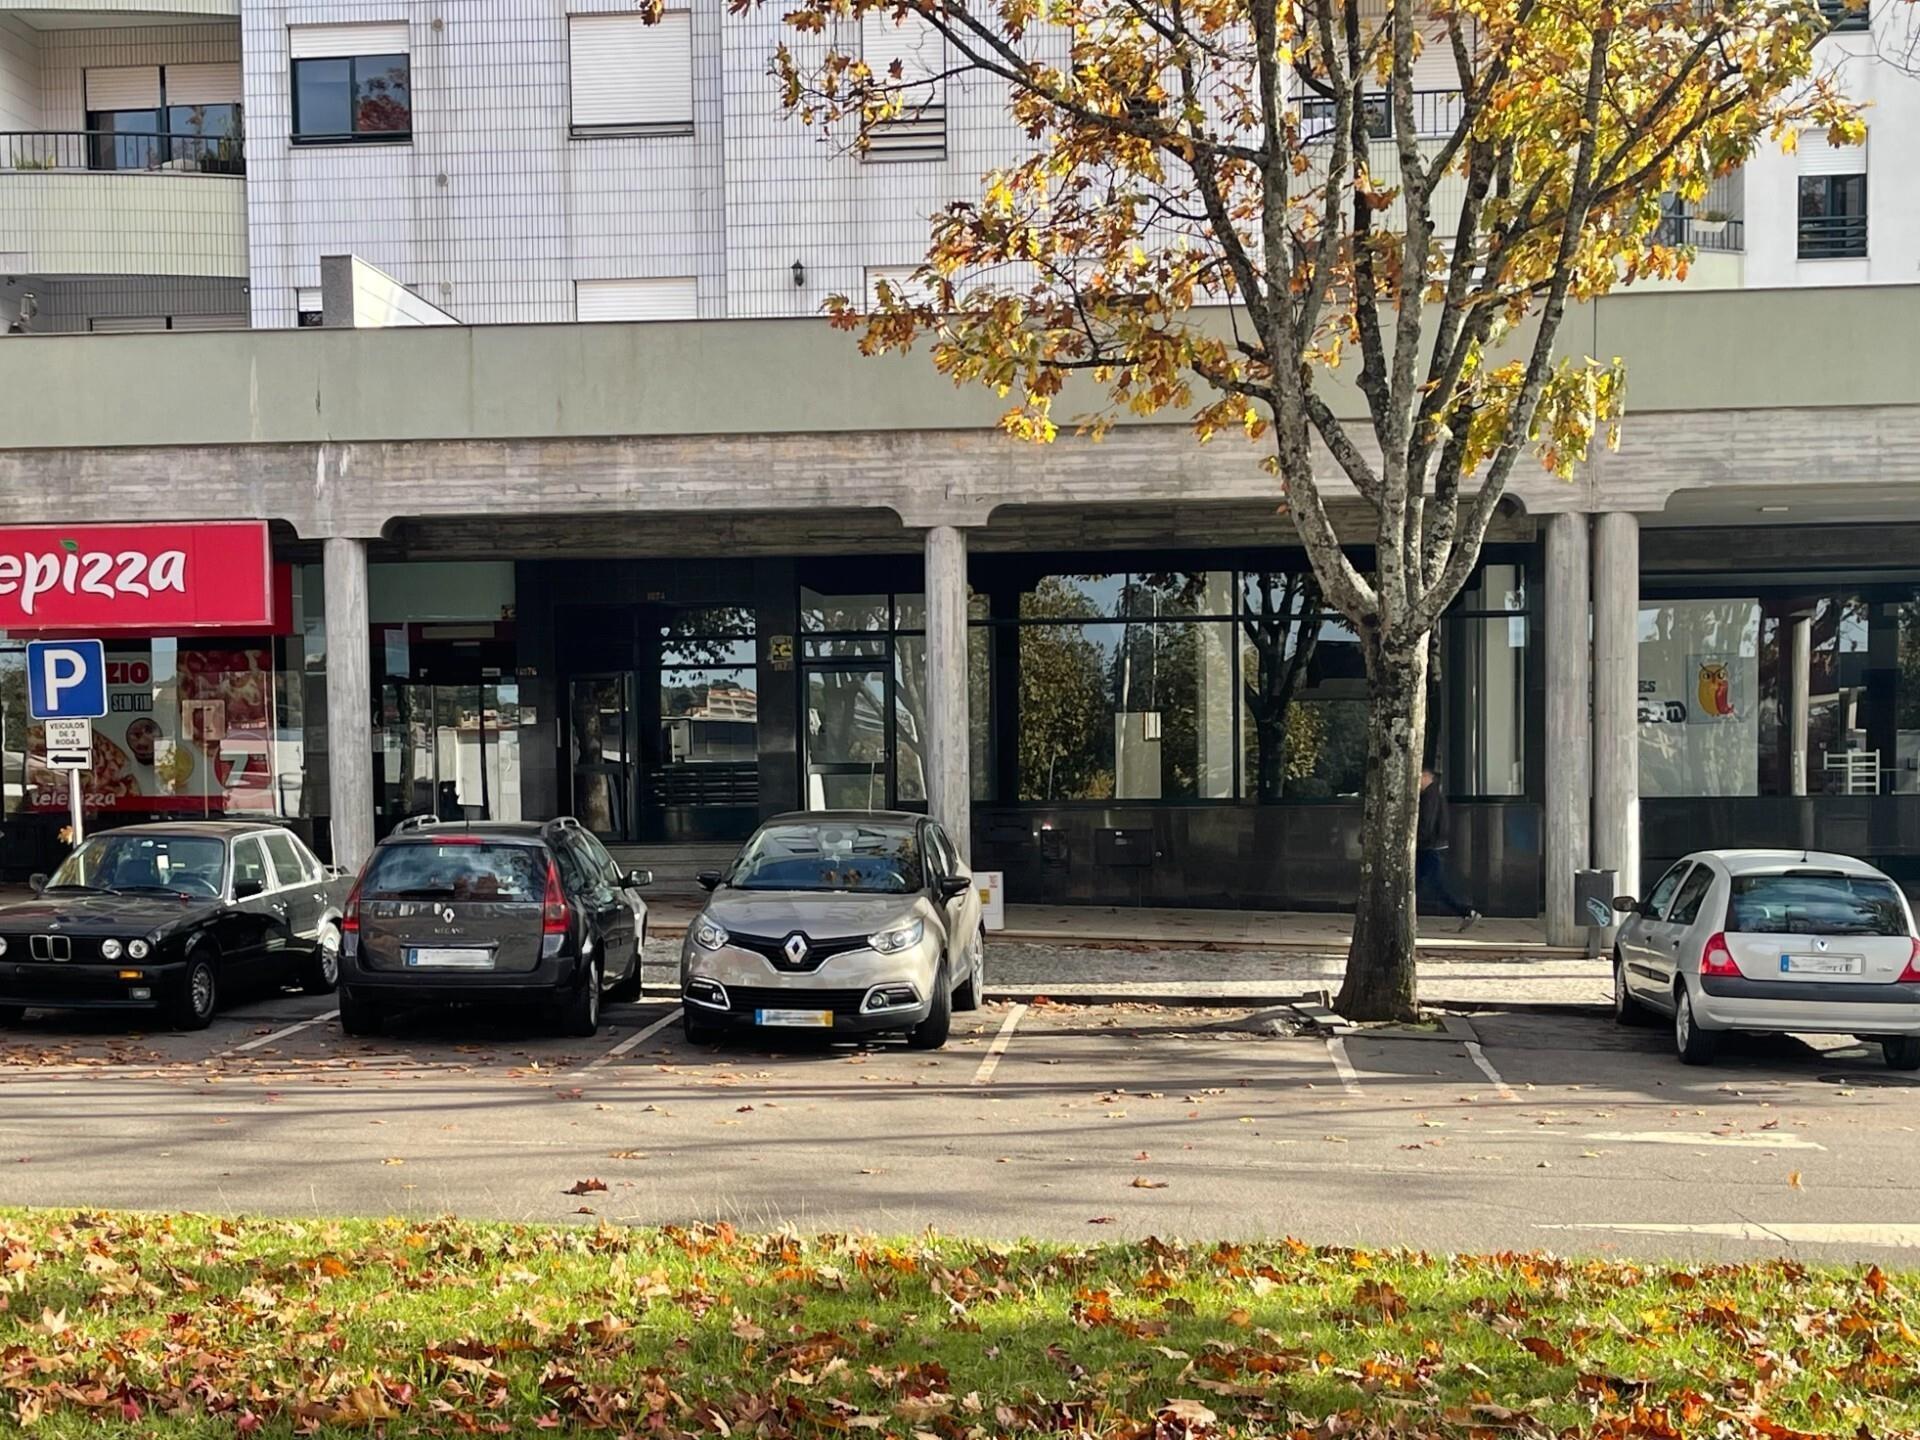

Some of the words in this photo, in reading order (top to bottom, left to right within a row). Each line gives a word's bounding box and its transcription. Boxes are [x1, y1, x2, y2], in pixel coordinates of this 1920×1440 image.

[44, 649, 87, 711] P
[112, 694, 133, 712] SEM
[31, 790, 116, 809] telezza
